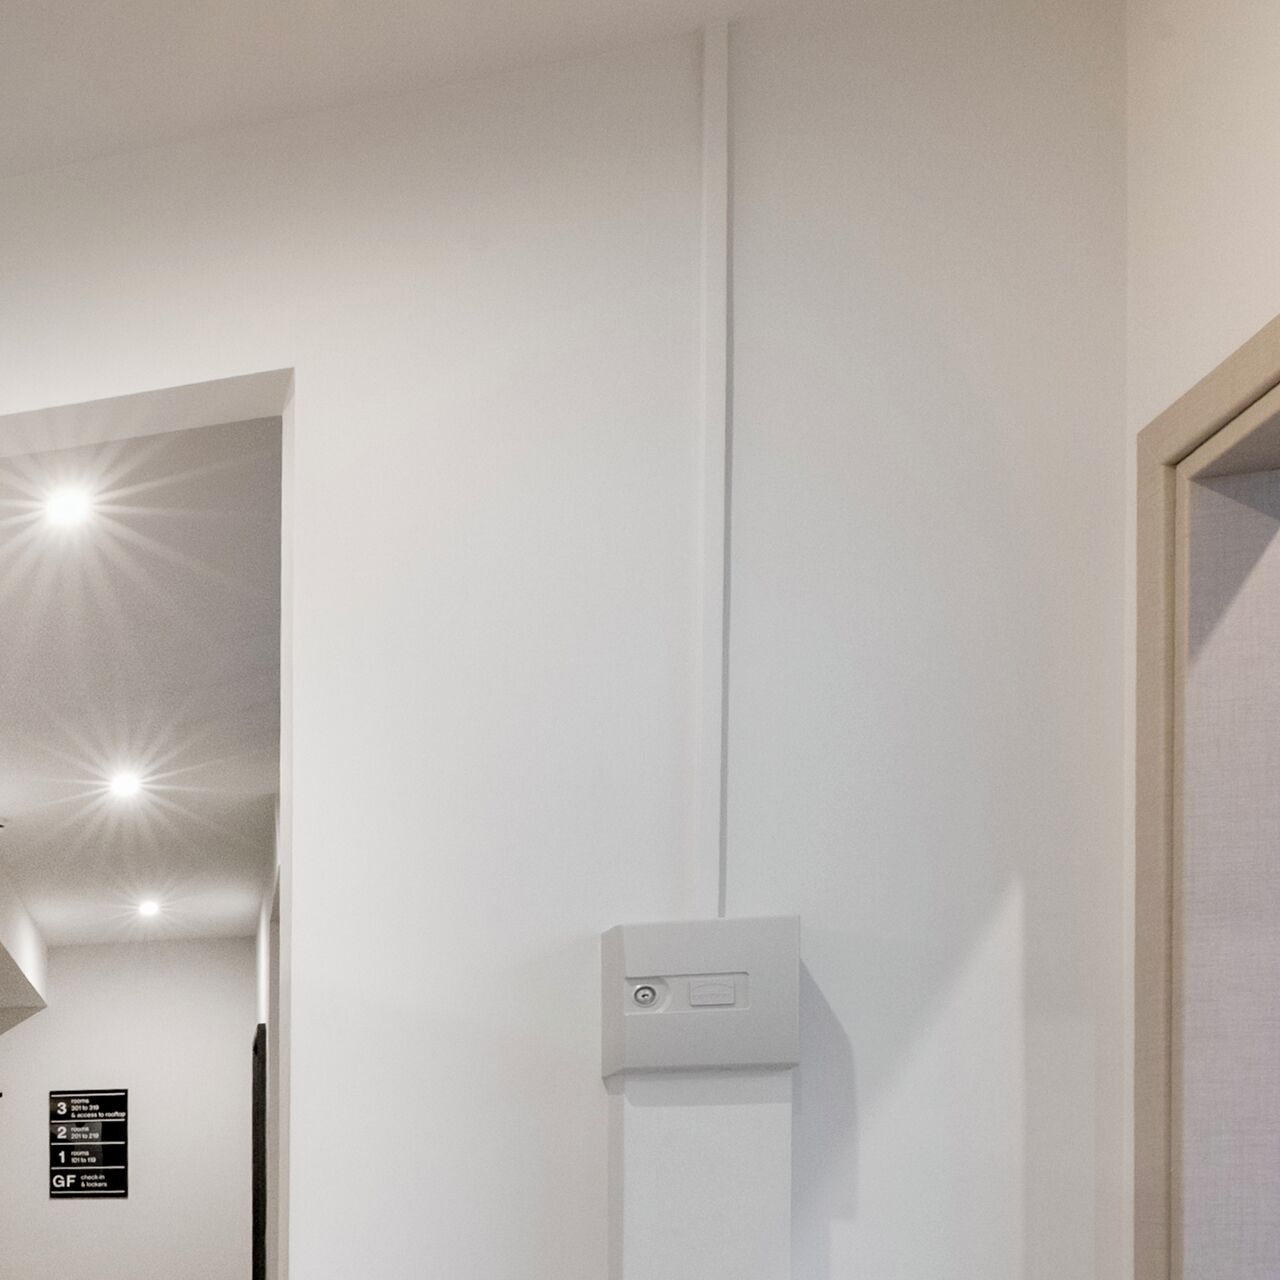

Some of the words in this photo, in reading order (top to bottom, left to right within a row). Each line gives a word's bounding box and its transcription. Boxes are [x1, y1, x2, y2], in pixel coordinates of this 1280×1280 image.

[57, 1102, 67, 1115] 3
[57, 1126, 67, 1139] 2
[59, 1150, 65, 1164] 1
[52, 1175, 76, 1188] GF
